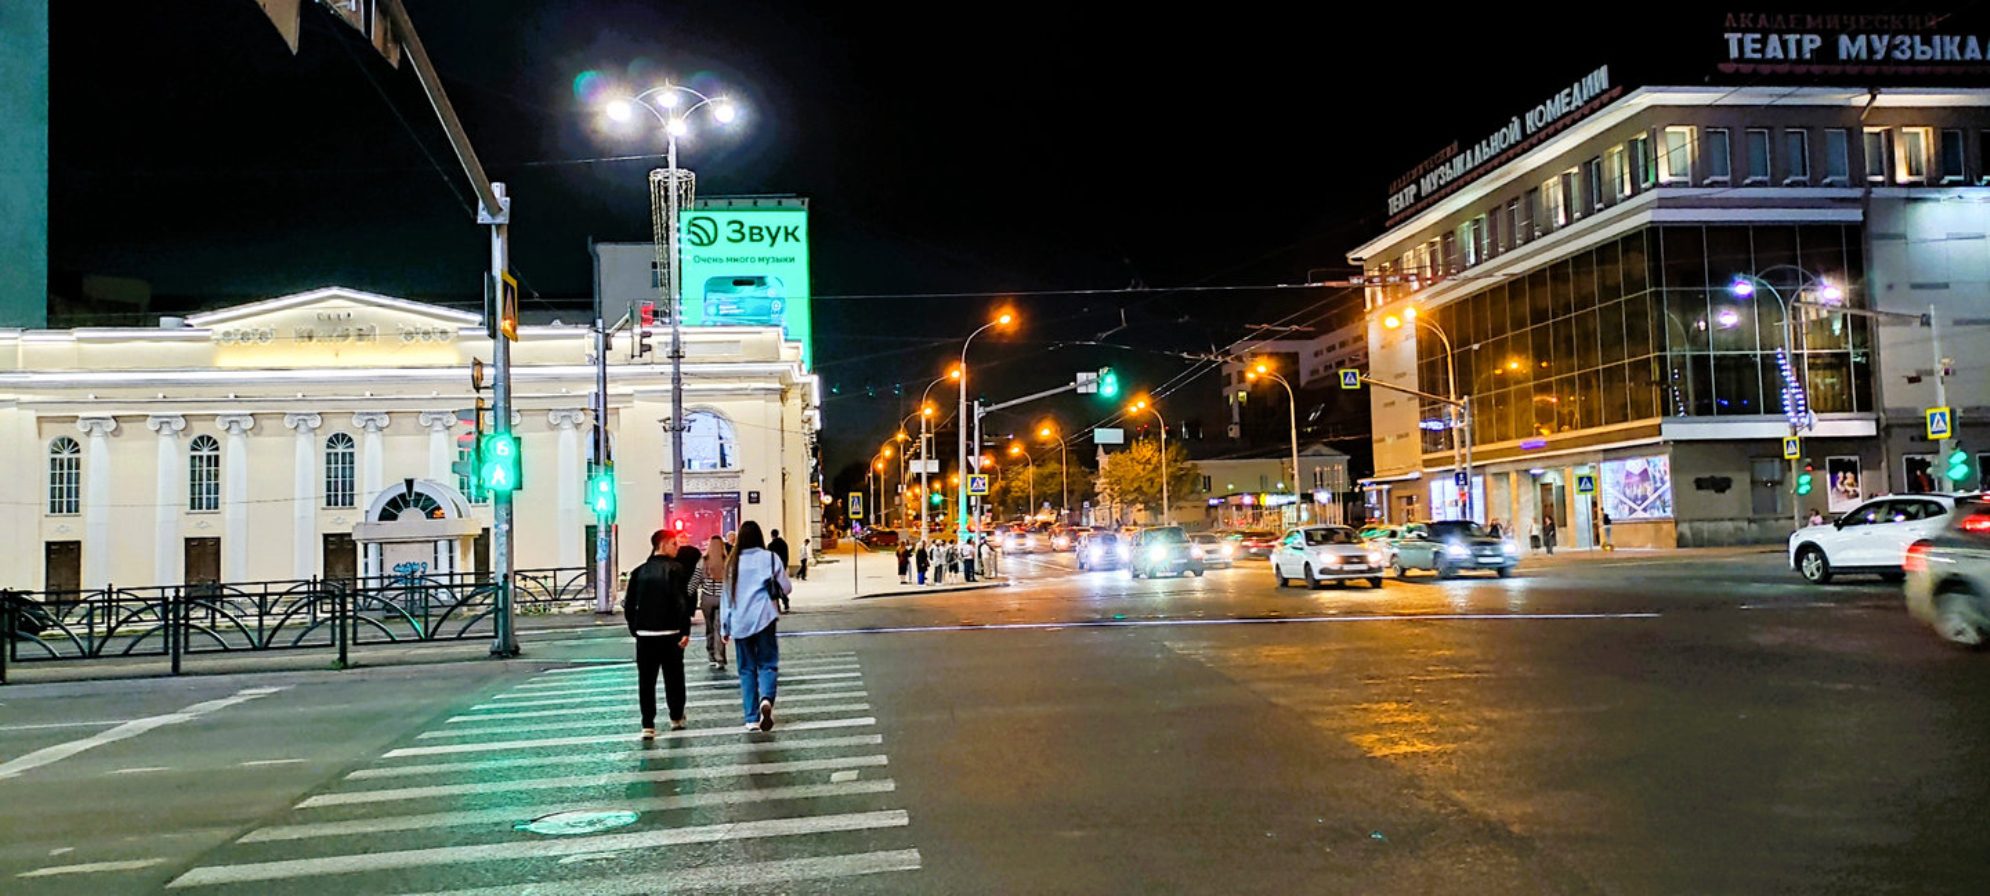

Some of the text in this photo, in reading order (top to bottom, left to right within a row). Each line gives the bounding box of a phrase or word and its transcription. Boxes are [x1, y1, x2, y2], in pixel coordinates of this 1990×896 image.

[1724, 33, 1990, 60] ТЕАТР МУЗЫКА
[1388, 64, 1610, 216] ТЕАТР МУЗЫКАЛЬНОЙ КОМЕДИИ
[726, 219, 801, 248] Звук
[693, 255, 796, 266] Очень много музыки
